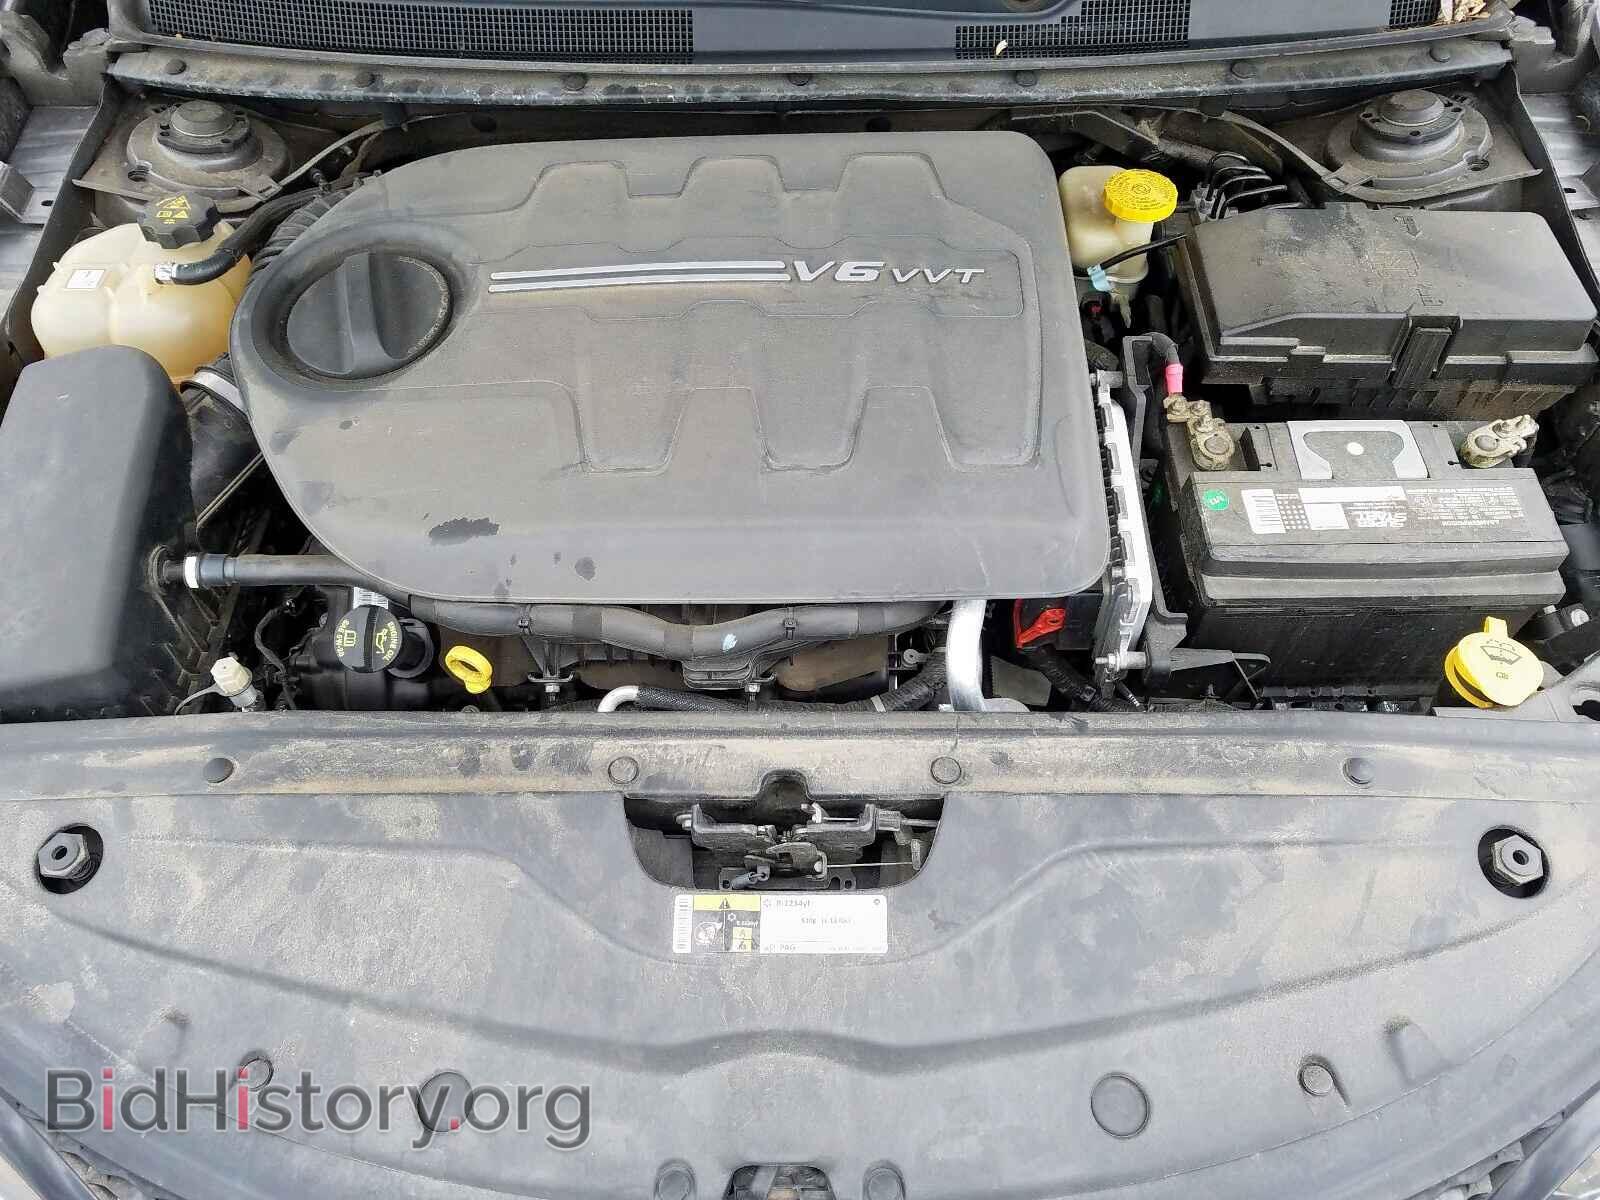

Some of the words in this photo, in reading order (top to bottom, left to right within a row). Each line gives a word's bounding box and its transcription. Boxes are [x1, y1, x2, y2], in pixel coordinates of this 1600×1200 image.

[793, 261, 886, 282] V6
[890, 268, 985, 283] VVT
[387, 621, 398, 648] ENGINE
